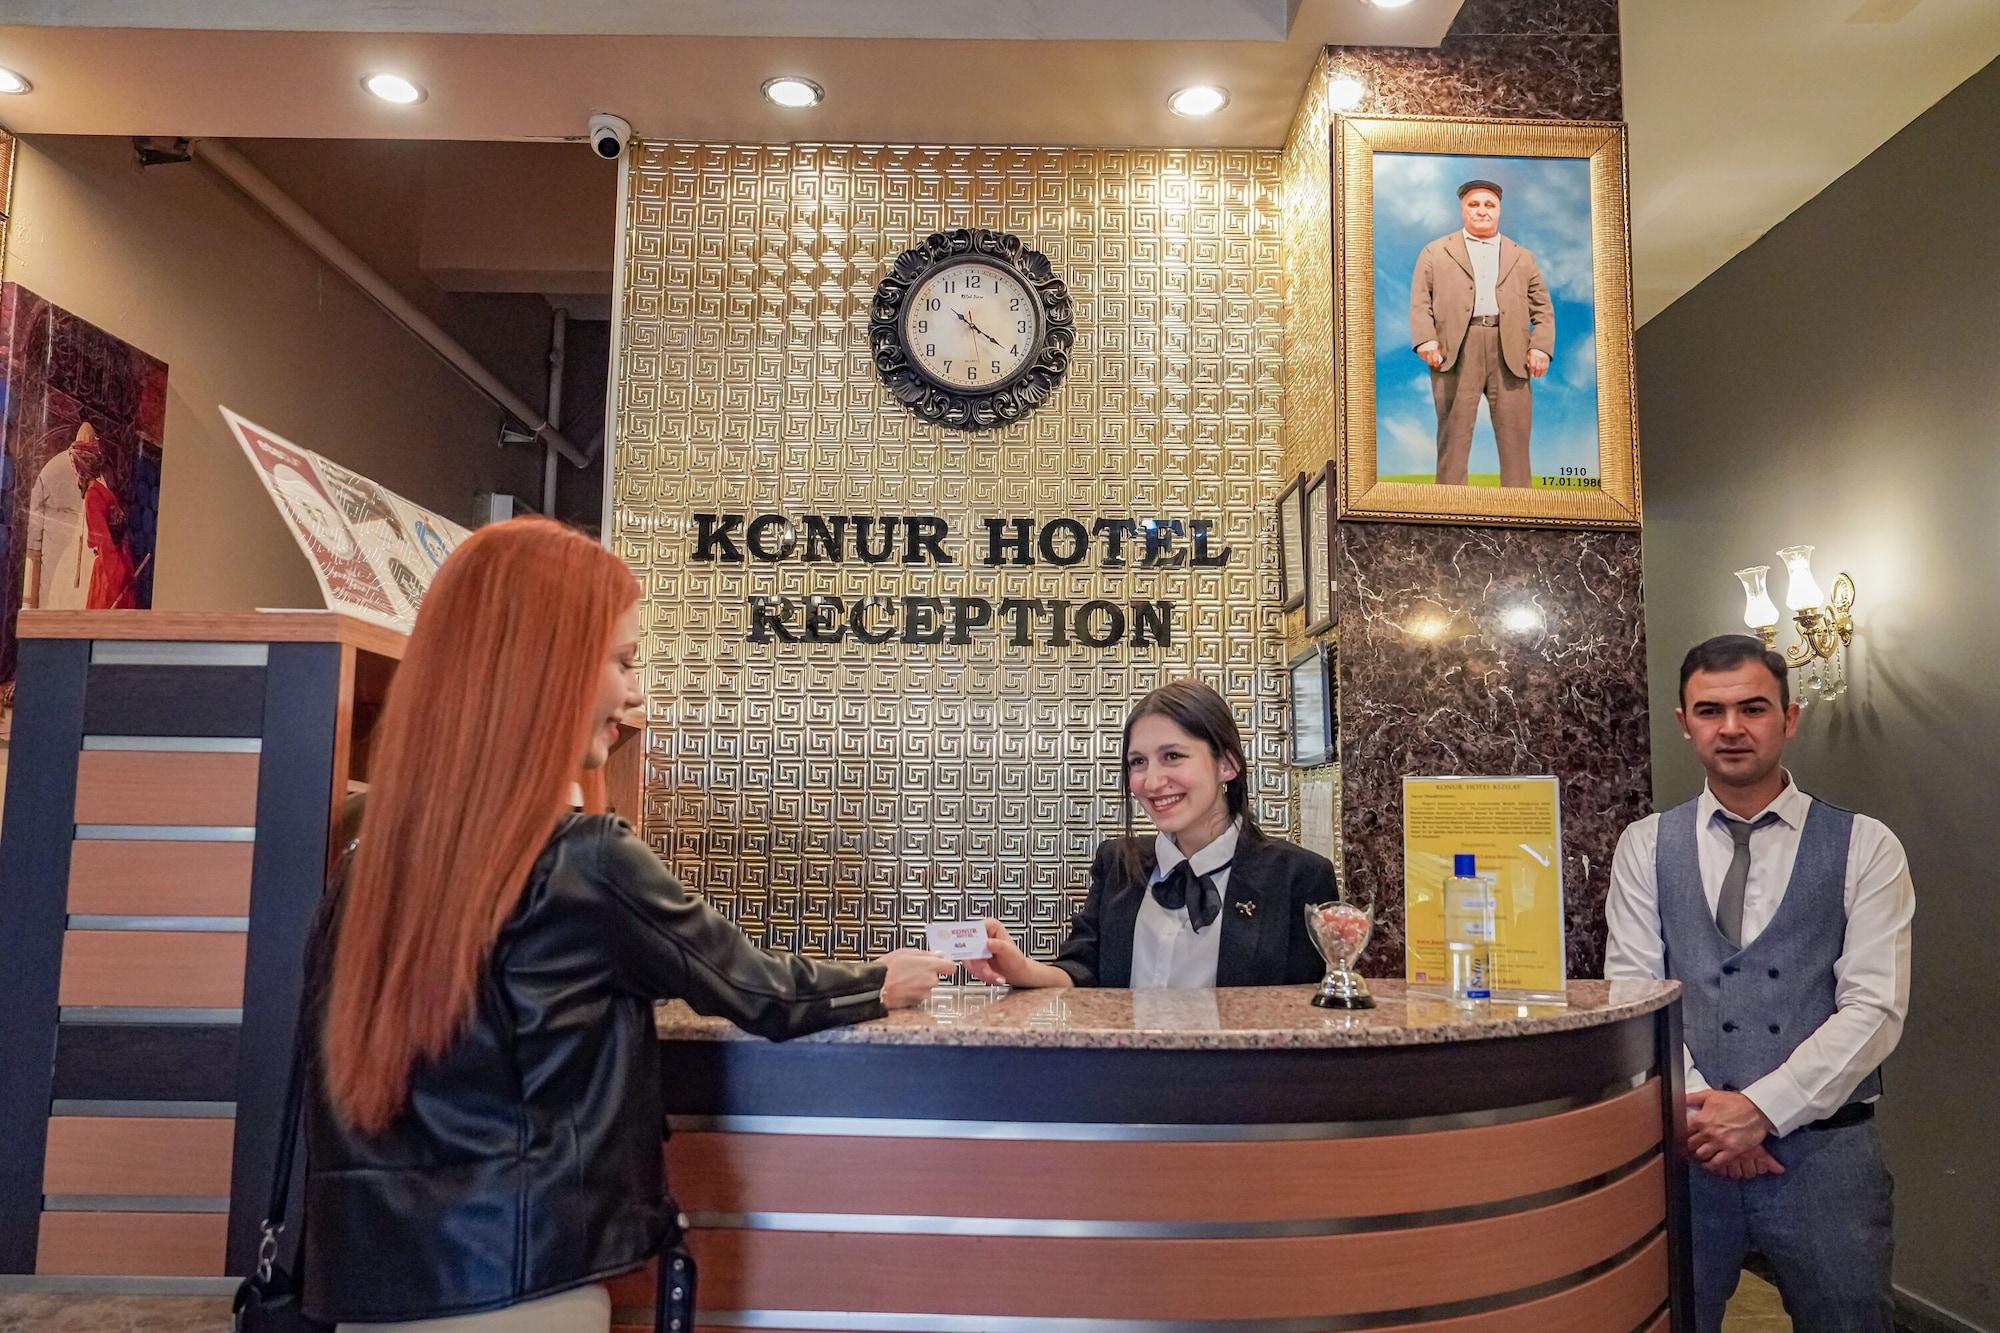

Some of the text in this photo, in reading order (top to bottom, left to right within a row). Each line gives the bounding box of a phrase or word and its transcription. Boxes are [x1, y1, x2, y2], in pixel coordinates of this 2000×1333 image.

[945, 281, 955, 293] 11
[966, 275, 980, 288] 12
[995, 281, 999, 293] 1
[926, 298, 941, 311] 10
[1010, 298, 1019, 311] 2
[918, 320, 927, 333] 9
[1017, 320, 1026, 333] 3
[926, 344, 935, 357] 8
[1010, 344, 1019, 357] 4
[943, 360, 952, 373] 7
[967, 366, 977, 380] 6
[991, 360, 1000, 373] 5
[1560, 467, 1587, 476] 1910
[692, 513, 1232, 569] KONUR HOTEL
[747, 596, 1176, 648] RECEPTION
